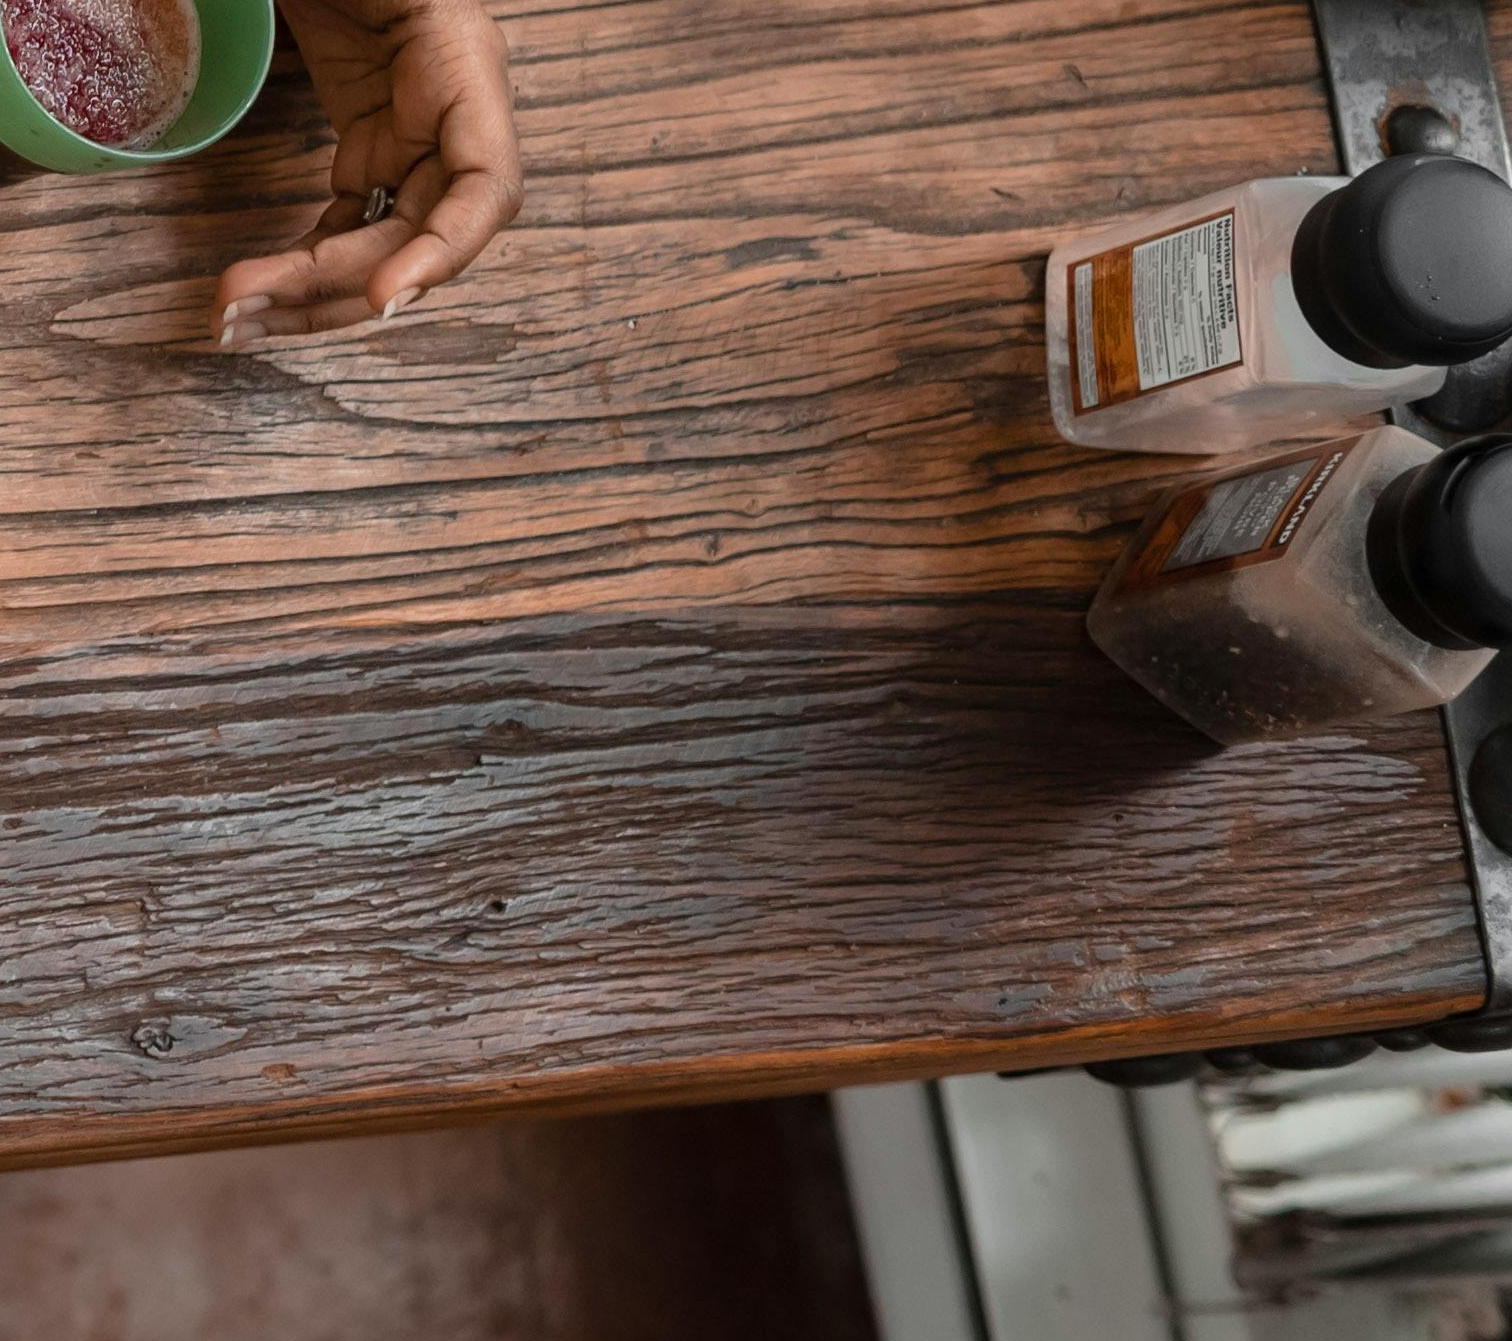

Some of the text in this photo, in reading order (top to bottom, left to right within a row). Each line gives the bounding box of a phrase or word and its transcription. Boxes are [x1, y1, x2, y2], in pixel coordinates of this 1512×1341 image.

[1216, 269, 1226, 329] nutritive
[1226, 284, 1234, 322] Facts
[1278, 452, 1343, 544] KIRKLAND
